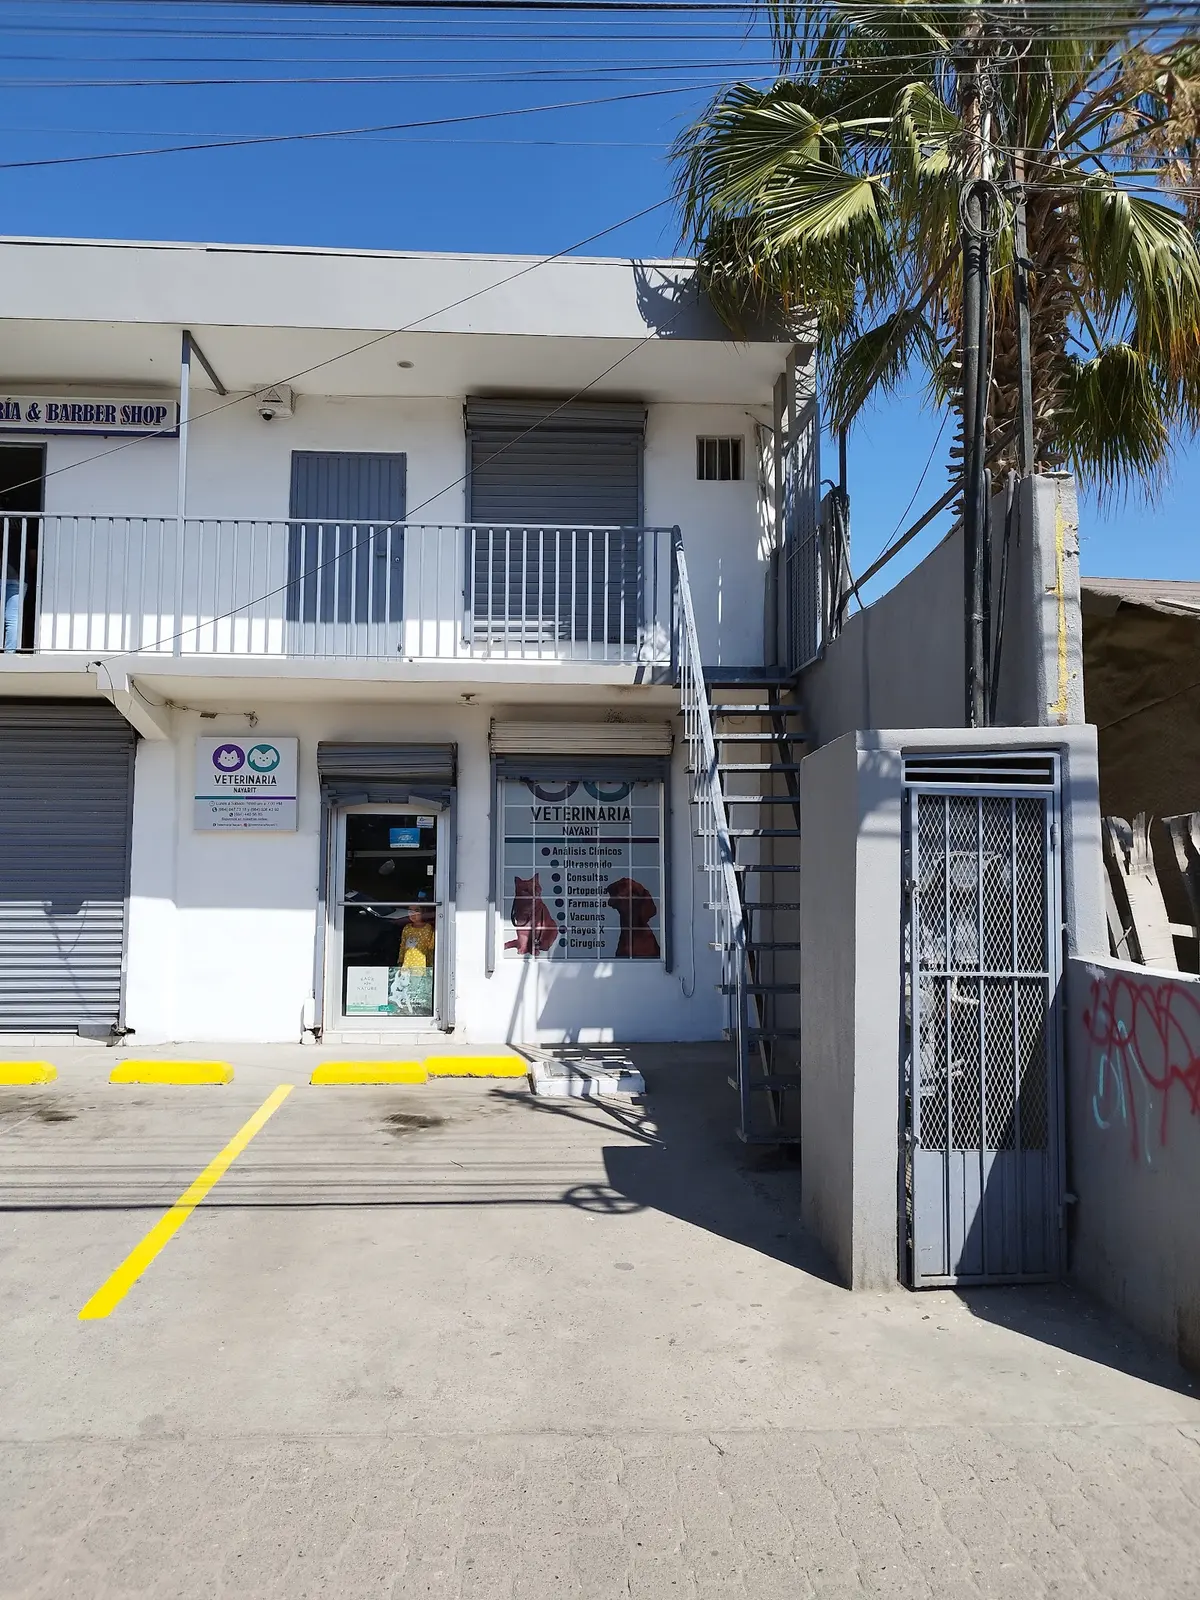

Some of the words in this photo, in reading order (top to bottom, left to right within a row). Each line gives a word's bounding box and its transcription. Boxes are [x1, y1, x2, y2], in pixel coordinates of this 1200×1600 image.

[25, 402, 42, 422] &
[46, 402, 116, 424] BARBER
[121, 404, 167, 425] SHOP
[214, 775, 277, 785] VETERINARIA
[531, 806, 632, 821] VETERINARIA
[562, 826, 600, 836] NAYARIT
[552, 846, 586, 856] Análisis
[589, 845, 622, 856] Clínicos
[563, 860, 612, 869] Ultrasonido
[567, 872, 608, 882] Consultas
[568, 898, 607, 908] Farmacia
[570, 912, 605, 921] Vacunas
[571, 925, 597, 936] Rayos
[598, 925, 605, 934] X
[570, 938, 605, 949] Cirugías
